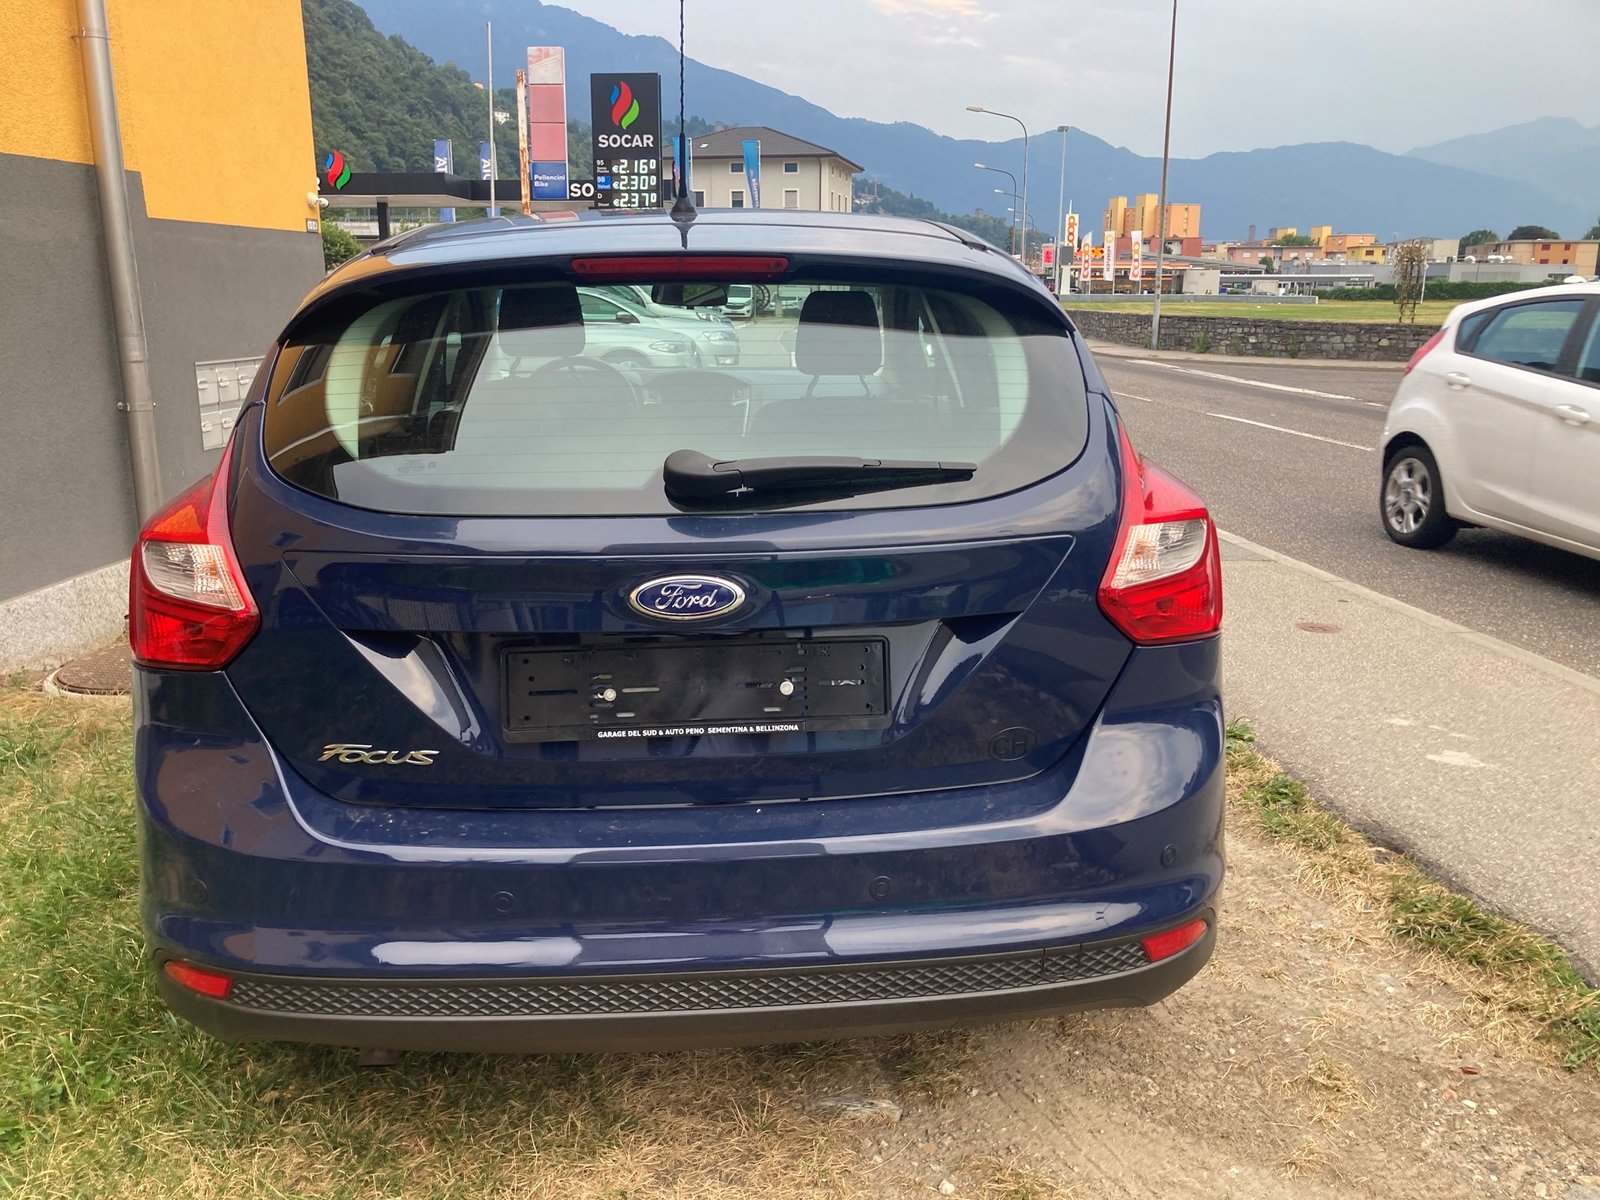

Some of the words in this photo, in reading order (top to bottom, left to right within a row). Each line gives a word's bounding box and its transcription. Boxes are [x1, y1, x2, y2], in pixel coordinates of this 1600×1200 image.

[598, 134, 654, 148] SOCAR
[655, 583, 718, 610] Ford
[597, 730, 627, 738] GARAGE
[627, 729, 642, 737] DEL
[642, 729, 658, 737] SUD
[658, 728, 664, 736] &
[665, 728, 684, 736] AUTO
[685, 727, 705, 735] PENO
[707, 726, 748, 734] SEMENTINA
[755, 724, 799, 732] BELLINZONA
